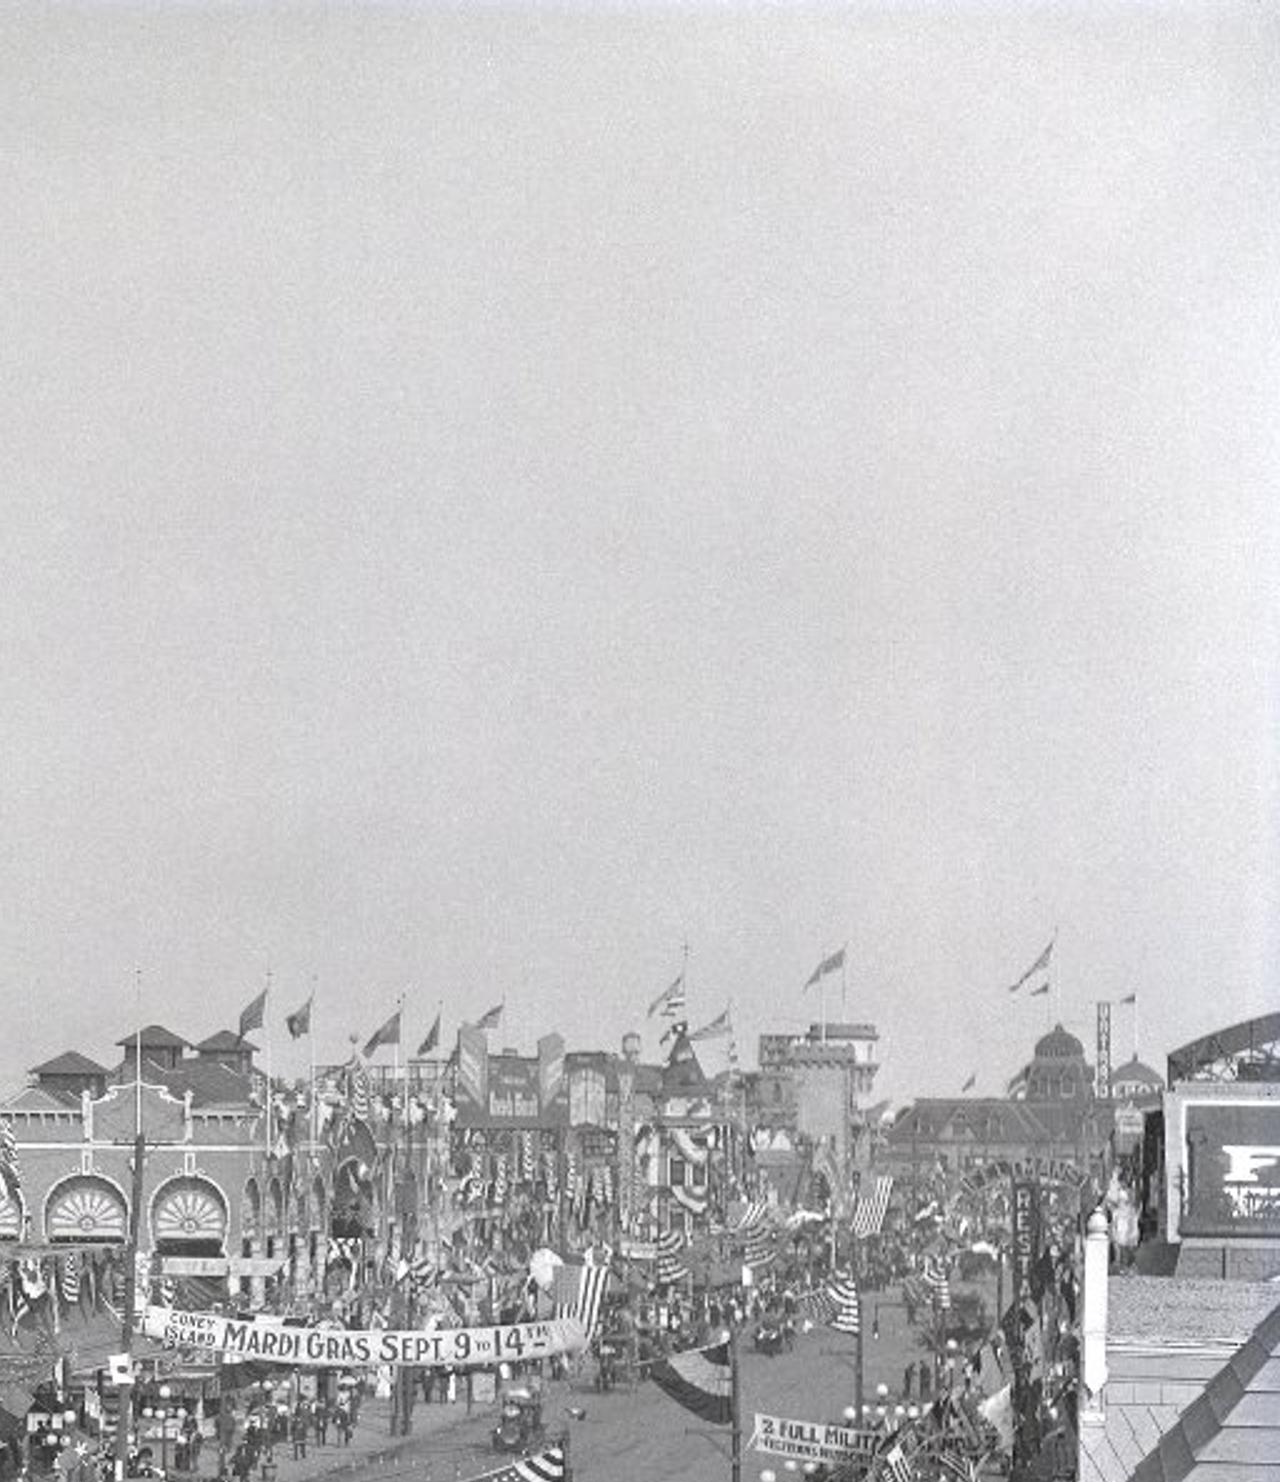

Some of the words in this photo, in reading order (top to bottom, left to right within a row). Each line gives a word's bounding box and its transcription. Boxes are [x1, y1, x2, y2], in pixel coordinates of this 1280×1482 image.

[170, 1312, 216, 1328] CONEY
[222, 1322, 300, 1358] MARDI
[306, 1329, 370, 1362] GRAS
[454, 1332, 471, 1359] 9
[475, 1341, 491, 1352] TO
